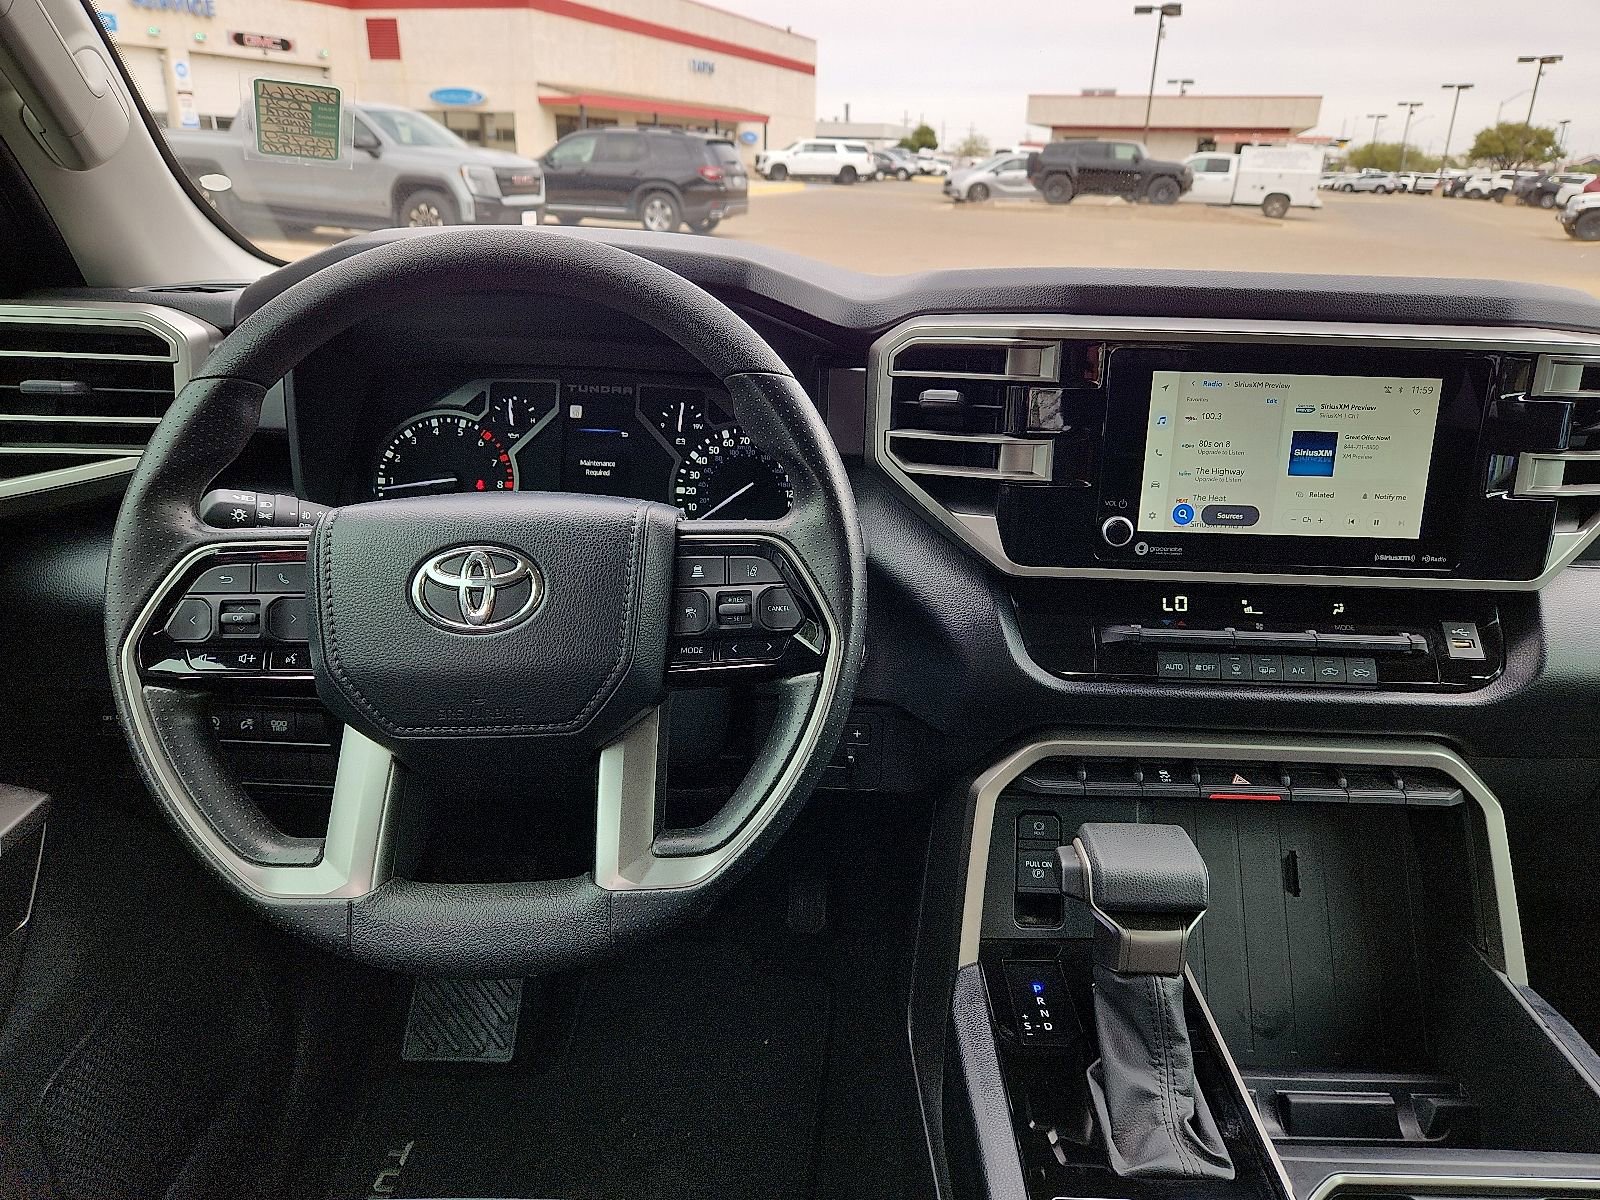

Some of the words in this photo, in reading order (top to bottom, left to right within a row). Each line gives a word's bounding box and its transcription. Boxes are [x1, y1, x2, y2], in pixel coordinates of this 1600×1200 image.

[567, 384, 633, 395] TUNDRA
[1411, 386, 1434, 394] 11:59
[1201, 412, 1223, 420] 100.3
[478, 439, 485, 447] 6
[723, 439, 734, 447] 60
[740, 437, 750, 445] 70
[1198, 440, 1212, 448] 80s
[709, 446, 720, 455] 50
[1294, 449, 1333, 457] SiriusXM
[580, 460, 616, 468] Maintenance
[696, 456, 708, 465] 40
[585, 469, 611, 477] Required
[689, 471, 700, 480] 30
[1195, 467, 1210, 475] The
[1211, 468, 1245, 477] Highway
[685, 487, 697, 496] 20
[785, 490, 794, 499] 12
[1308, 491, 1335, 499] Related
[1374, 493, 1395, 501] Notify
[687, 503, 697, 511] 10
[1217, 512, 1244, 520] Sources
[1162, 595, 1188, 612] LO
[680, 646, 704, 654] MODE
[1165, 663, 1183, 671] AUTO
[1202, 664, 1216, 672] OFF
[1291, 667, 1306, 675] A/C
[1025, 860, 1040, 868] PULL
[1032, 984, 1042, 993] P
[1036, 996, 1046, 1005] R
[1039, 1009, 1050, 1018] N
[1023, 1022, 1032, 1030] S
[1043, 1022, 1053, 1031] D
